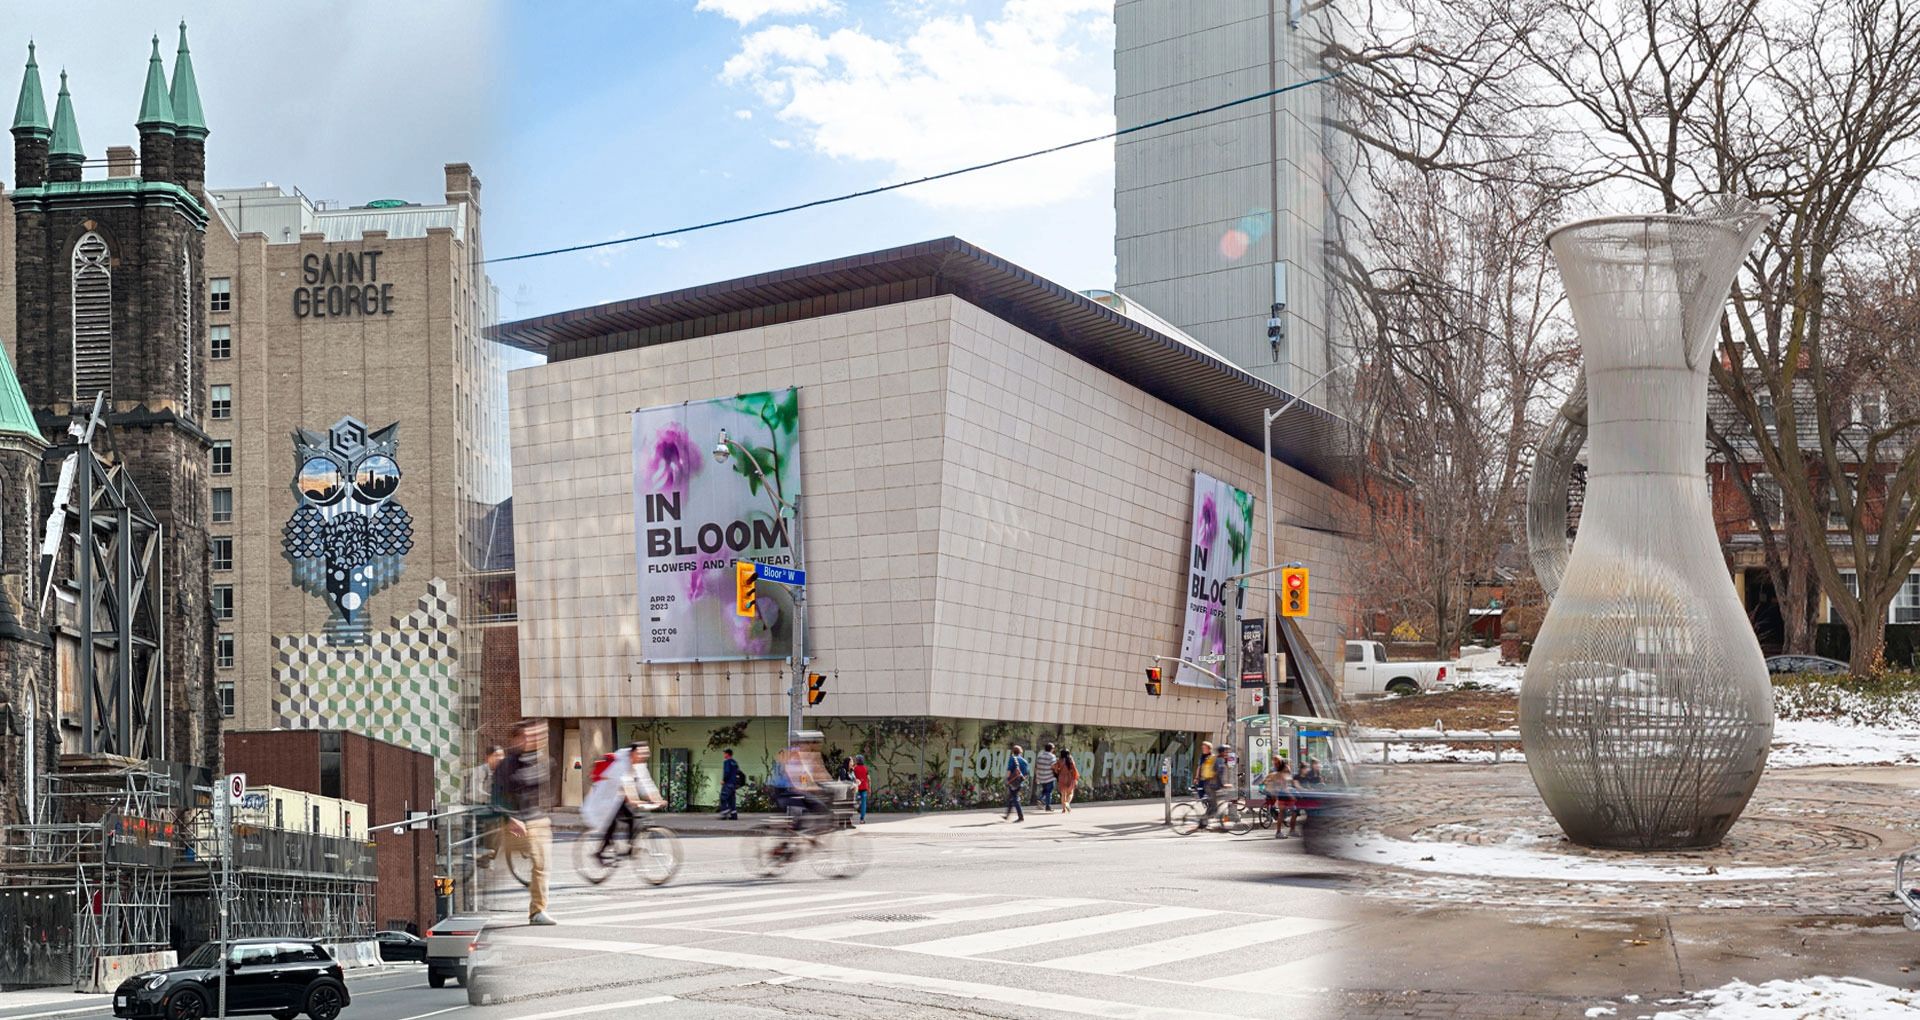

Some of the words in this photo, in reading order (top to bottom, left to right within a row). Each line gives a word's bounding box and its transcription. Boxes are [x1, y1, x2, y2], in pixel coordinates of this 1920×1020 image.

[303, 250, 383, 285] SAINT
[293, 283, 394, 318] GEORGE
[645, 491, 681, 523] IN
[647, 517, 789, 558] BLOOM
[648, 561, 697, 574] FLOWERS
[702, 559, 725, 570] AND
[730, 555, 791, 568] FTWEAR
[1193, 544, 1208, 572] IN
[763, 566, 782, 579] Bloor
[787, 570, 796, 581] W
[650, 595, 665, 603] APR
[650, 602, 669, 610] 2023
[651, 628, 667, 636] OCT
